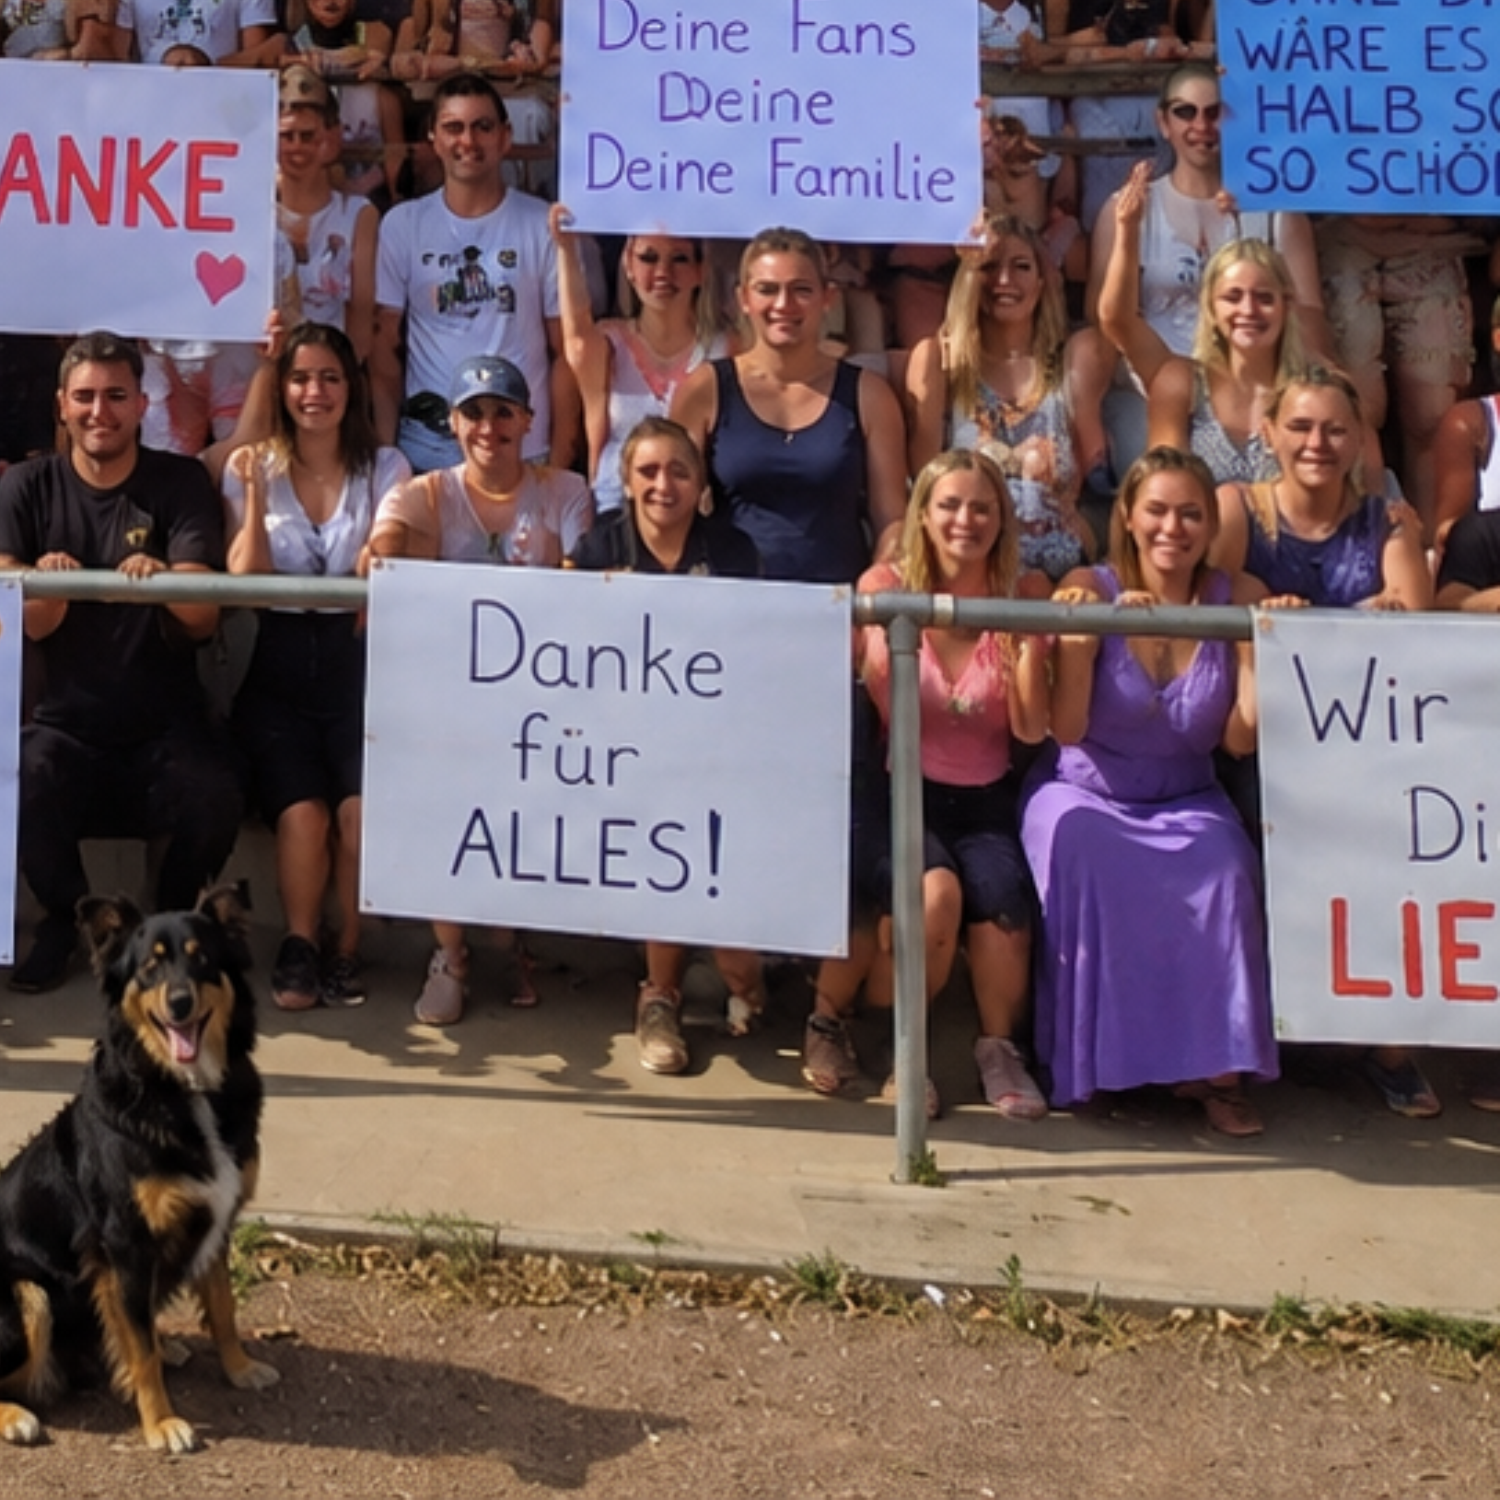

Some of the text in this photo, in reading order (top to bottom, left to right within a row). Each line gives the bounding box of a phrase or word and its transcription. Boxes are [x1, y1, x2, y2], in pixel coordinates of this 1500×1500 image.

[1424, 25, 1488, 72] ES
[1257, 83, 1422, 134] HALB
[586, 133, 956, 203] Deine Familie
[1245, 140, 1500, 197] SO SCHÖ
[469, 598, 723, 699] Danke
[1293, 654, 1449, 742] Wir
[512, 713, 640, 787] für
[451, 808, 722, 899] ALLES!
[1408, 785, 1500, 864] Di
